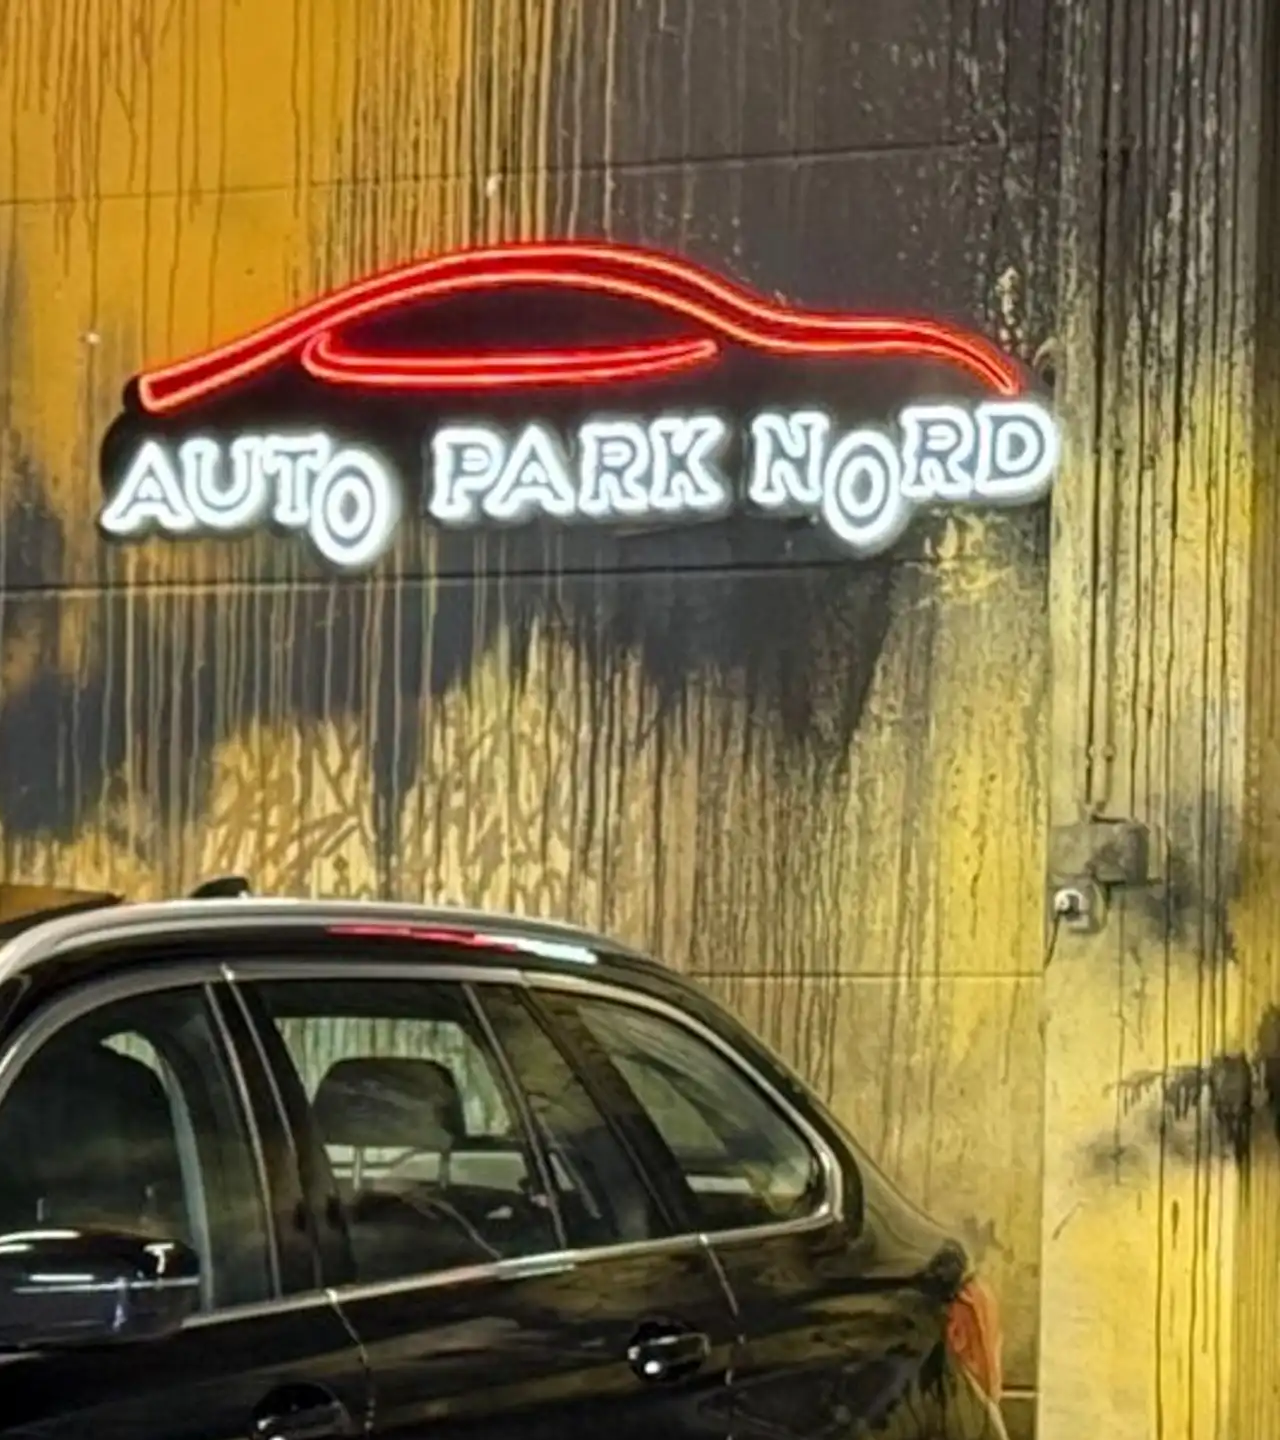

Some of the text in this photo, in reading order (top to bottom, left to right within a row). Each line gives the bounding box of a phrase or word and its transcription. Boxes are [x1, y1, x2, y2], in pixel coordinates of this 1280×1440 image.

[100, 401, 1059, 567] AUTO PARK NORD
